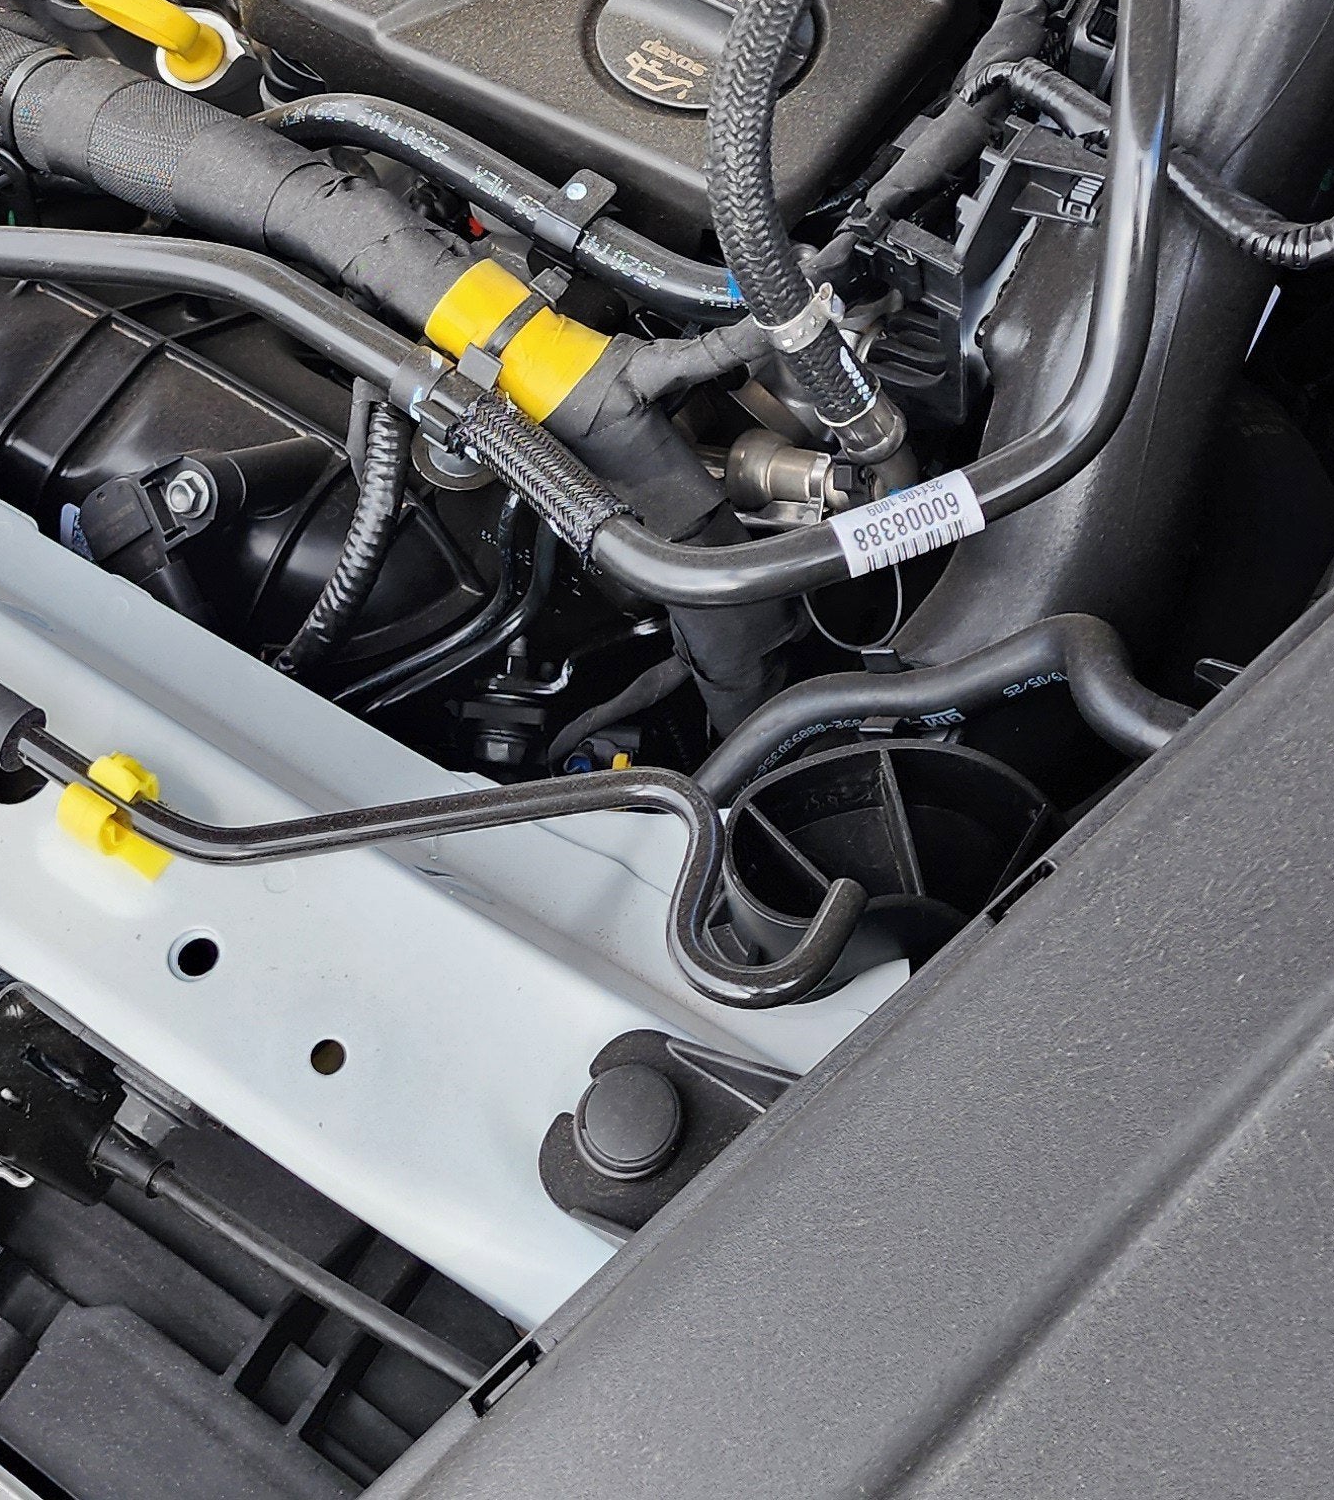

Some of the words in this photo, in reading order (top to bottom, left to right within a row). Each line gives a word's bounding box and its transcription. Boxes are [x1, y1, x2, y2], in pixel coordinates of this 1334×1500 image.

[640, 39, 708, 78] dexos
[469, 164, 514, 202] MEX
[867, 495, 898, 518] 1009
[903, 479, 944, 504] 251106
[853, 491, 960, 552] 60008388
[920, 708, 966, 728] GM
